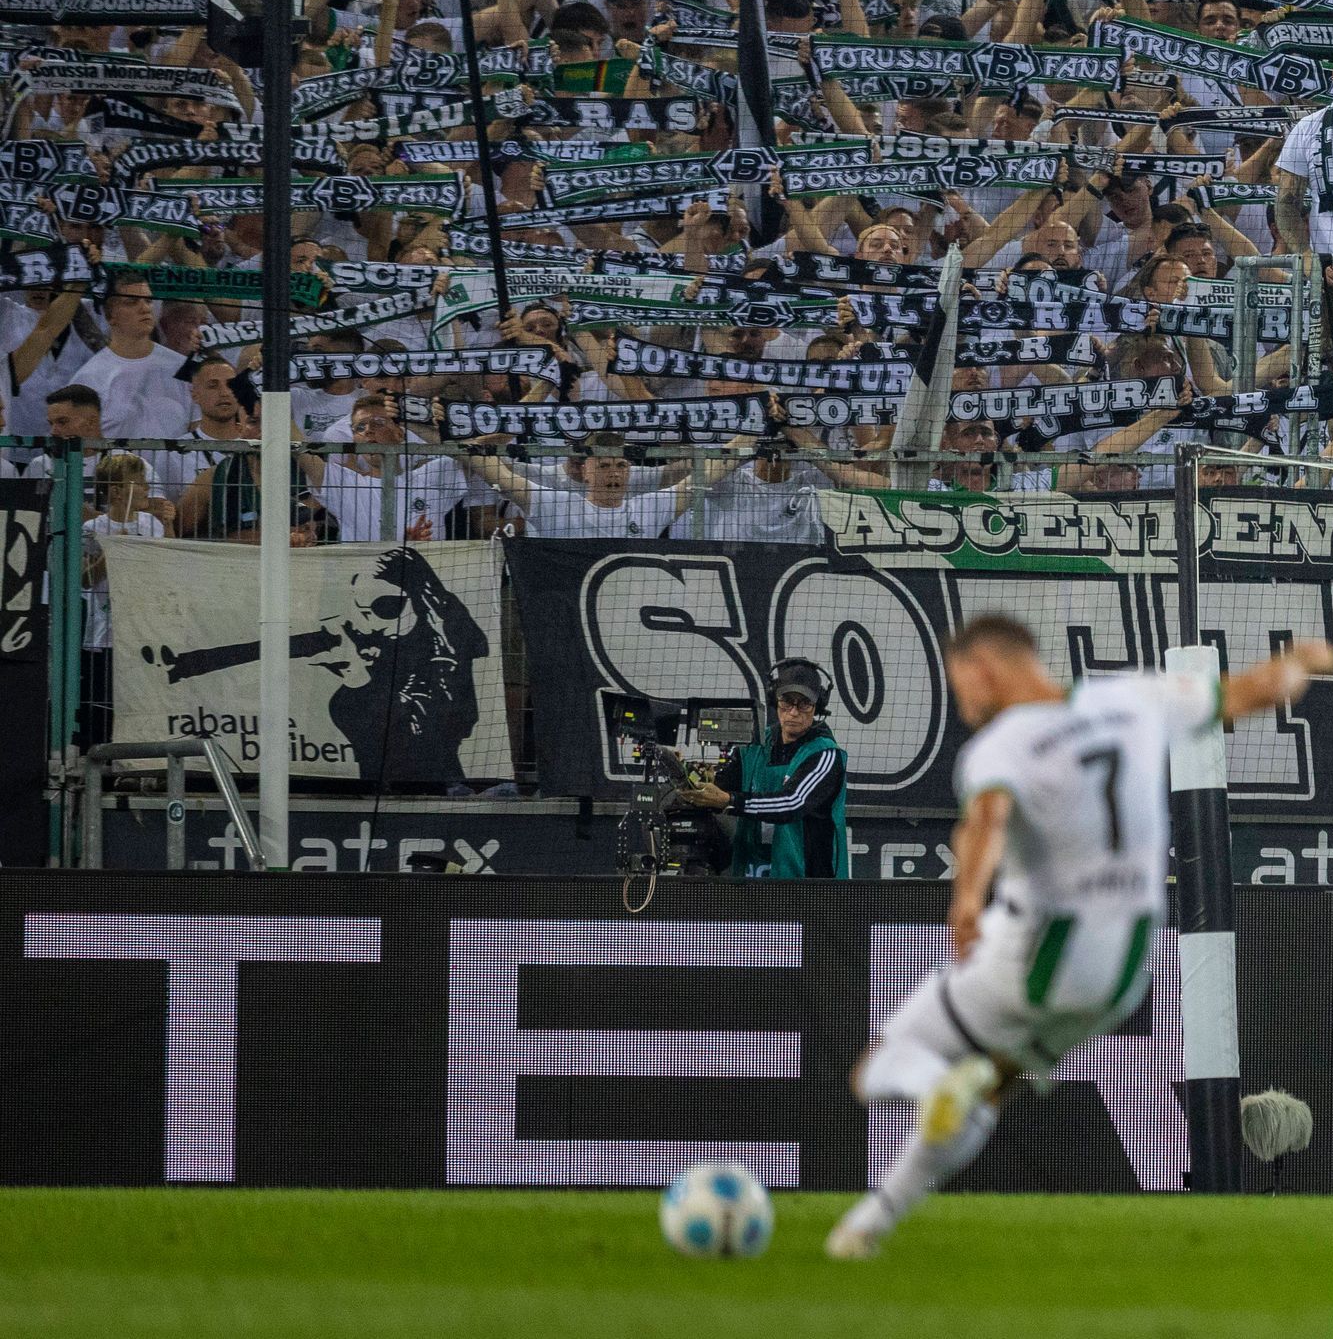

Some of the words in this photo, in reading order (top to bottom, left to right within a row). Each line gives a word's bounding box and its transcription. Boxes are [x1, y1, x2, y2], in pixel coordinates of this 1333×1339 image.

[817, 49, 965, 75] BORUSSIA
[1042, 56, 1120, 81] FANS
[1102, 26, 1252, 78] BORUSSIA
[554, 161, 706, 193] BORUSSIA
[787, 167, 927, 194] BORUSSIA
[1147, 160, 1223, 175] 1900
[380, 181, 457, 204] FANS
[506, 273, 569, 288] BORUSSIA
[574, 276, 596, 285] VFL
[606, 276, 631, 286] 1900
[787, 376, 1178, 428] SOTTCULTURA
[447, 398, 767, 440] SOTTOCULTURA
[167, 710, 297, 737] rabaue
[1080, 744, 1127, 850] 7
[206, 822, 500, 872] fatex
